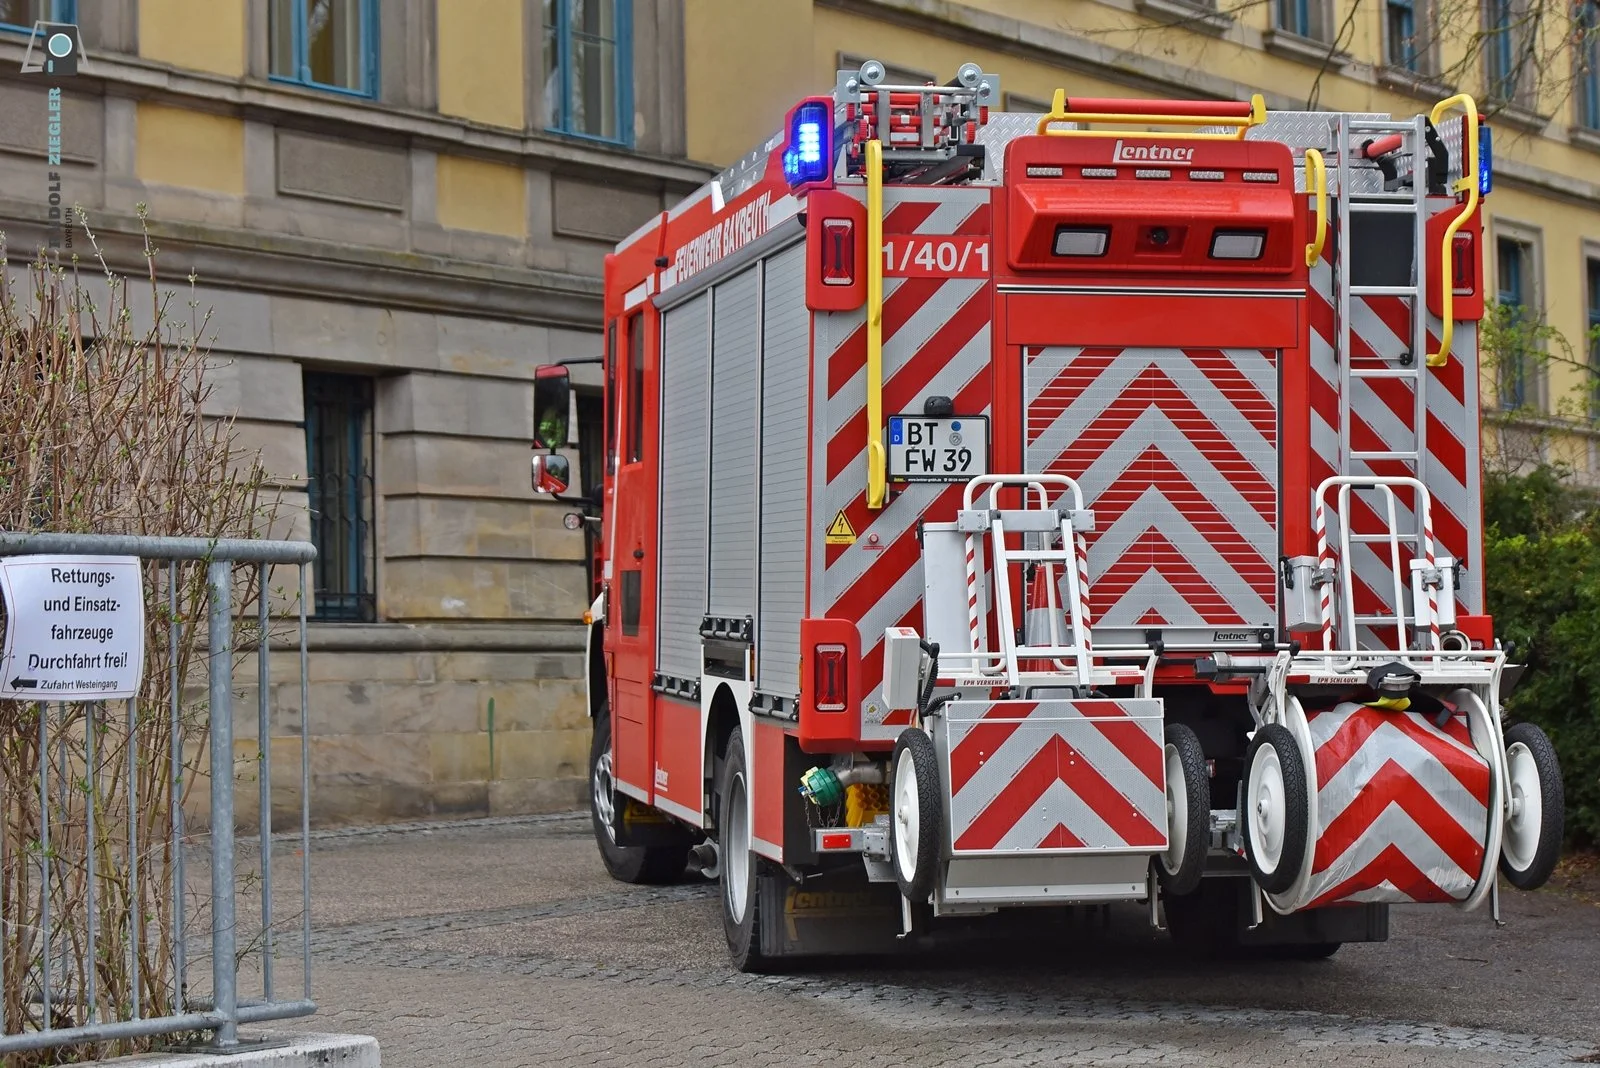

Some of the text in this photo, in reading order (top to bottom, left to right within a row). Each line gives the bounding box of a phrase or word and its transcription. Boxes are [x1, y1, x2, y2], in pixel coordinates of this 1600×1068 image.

[675, 189, 772, 284] FEUERWEHR BAYREUTH
[882, 240, 989, 272] 1/40/1
[893, 434, 900, 442] D
[907, 422, 938, 445] BT
[905, 449, 972, 472] FW 39
[51, 567, 115, 588] Rettungs-
[44, 596, 121, 612] und Einsatz-
[51, 624, 114, 643] fahrzeuge
[28, 652, 128, 670] Durchfahrt frei!
[41, 679, 118, 691] Zufahrt Westeingang
